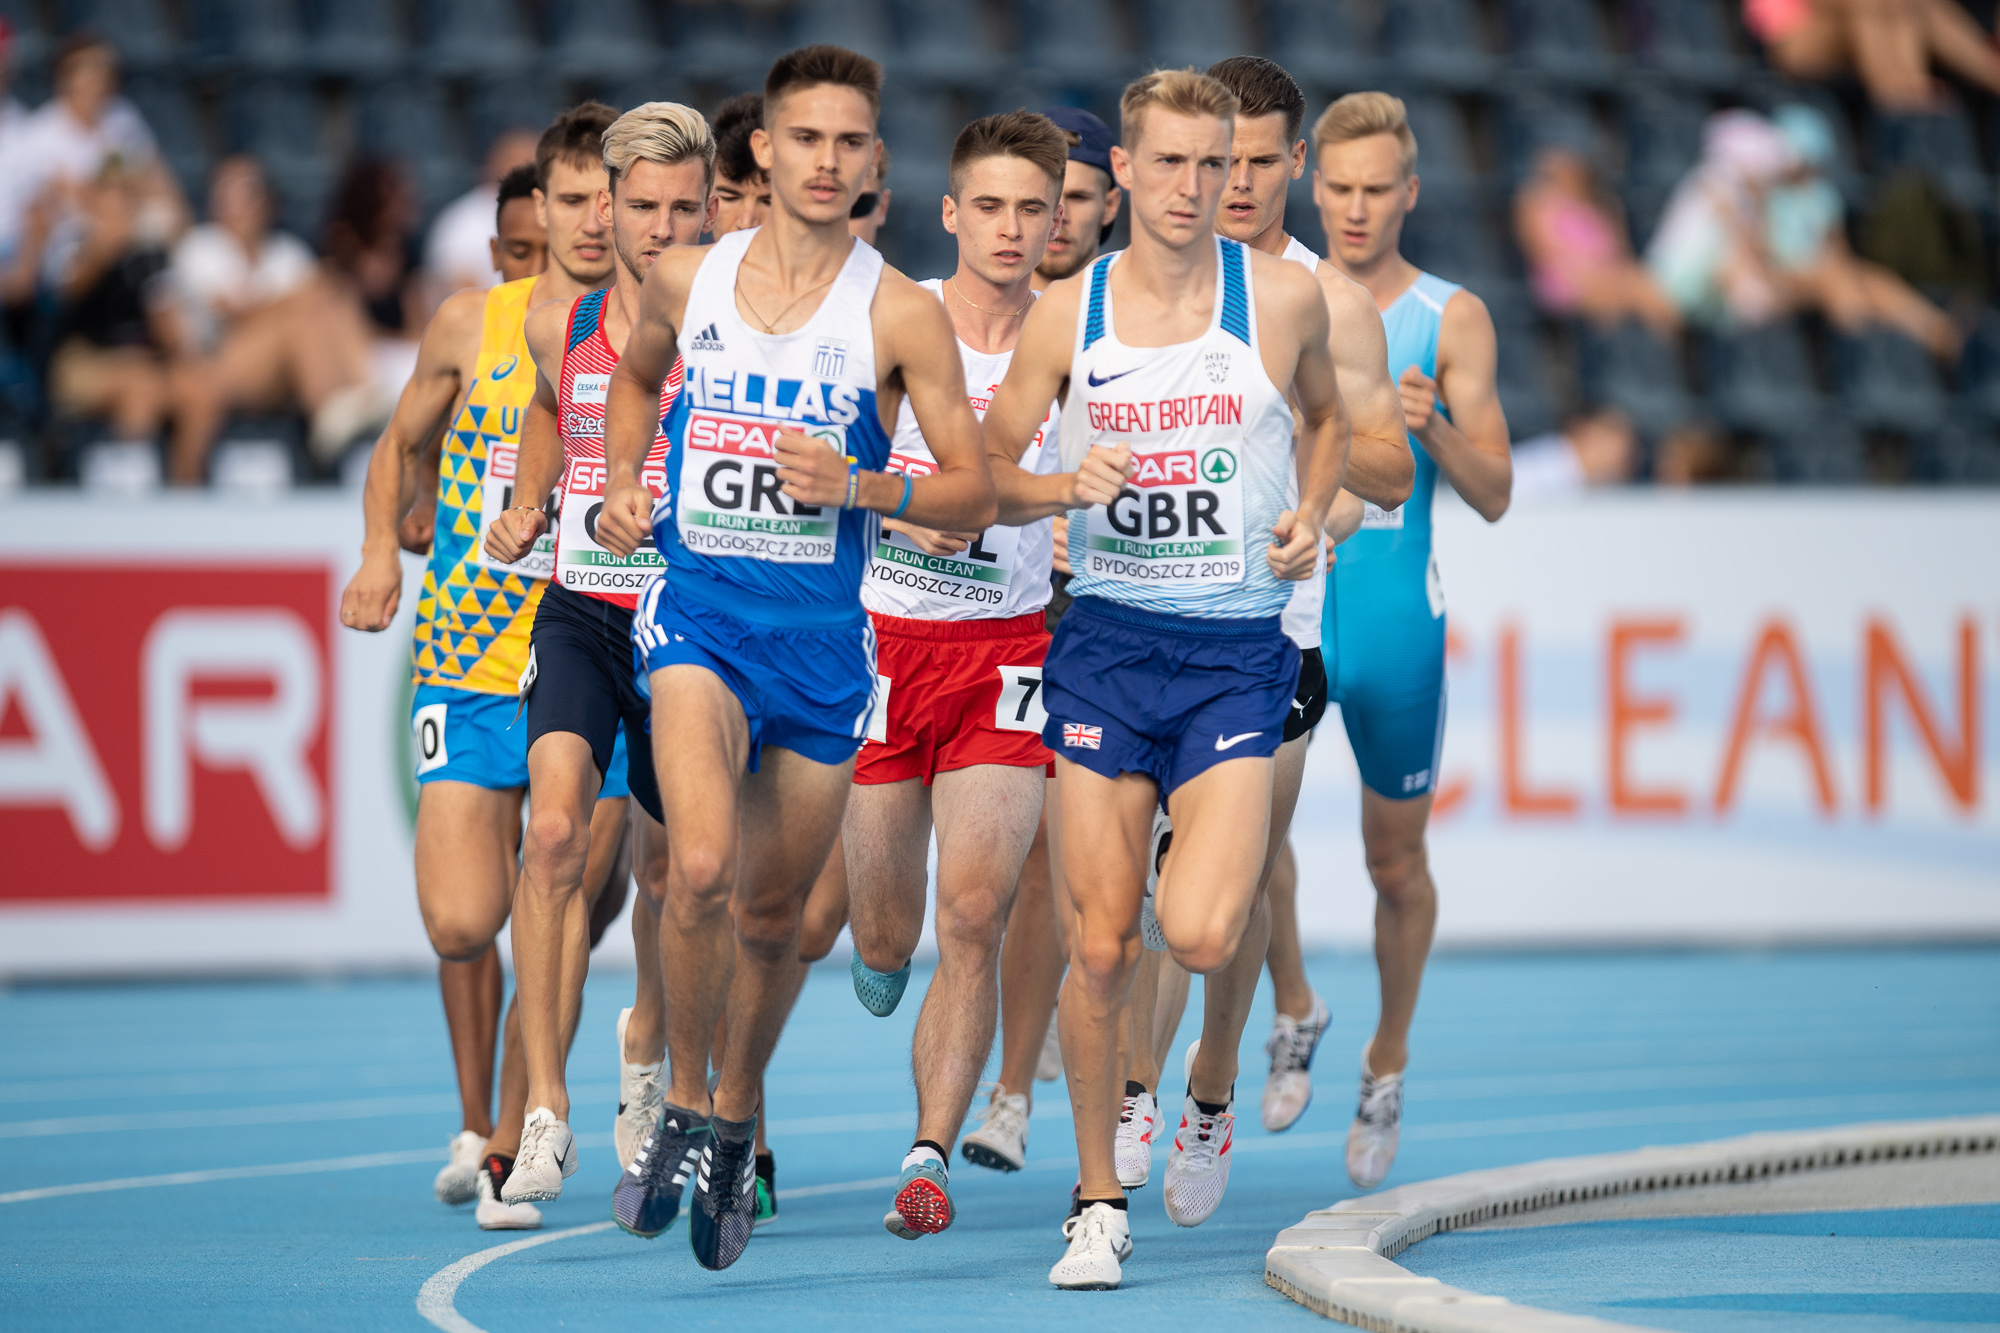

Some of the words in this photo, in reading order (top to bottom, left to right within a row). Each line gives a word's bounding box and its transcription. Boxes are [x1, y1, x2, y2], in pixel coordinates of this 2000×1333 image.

[692, 339, 725, 351] adidas
[684, 366, 861, 425] HELLAS
[1088, 402, 1156, 432] GREAT
[1159, 394, 1243, 430] BRITAIN
[691, 419, 781, 454] SPA
[716, 514, 748, 529] RUN
[1107, 488, 1228, 539] GBR
[687, 529, 789, 558] BYDGOSZCZ
[793, 542, 832, 557] 2019
[1116, 541, 1121, 552] I
[1124, 541, 1152, 557] RUN
[591, 552, 596, 563] I
[630, 554, 668, 566] CLEA
[886, 547, 892, 558] I
[894, 550, 924, 567] RUN
[1093, 556, 1196, 579] BYDGOSZCZ
[1201, 561, 1240, 577] 2019
[565, 570, 664, 588] BYDGOSZ
[870, 563, 962, 598] YDGOSZCZ
[964, 585, 1004, 605] 2019
[1017, 676, 1042, 722] 7
